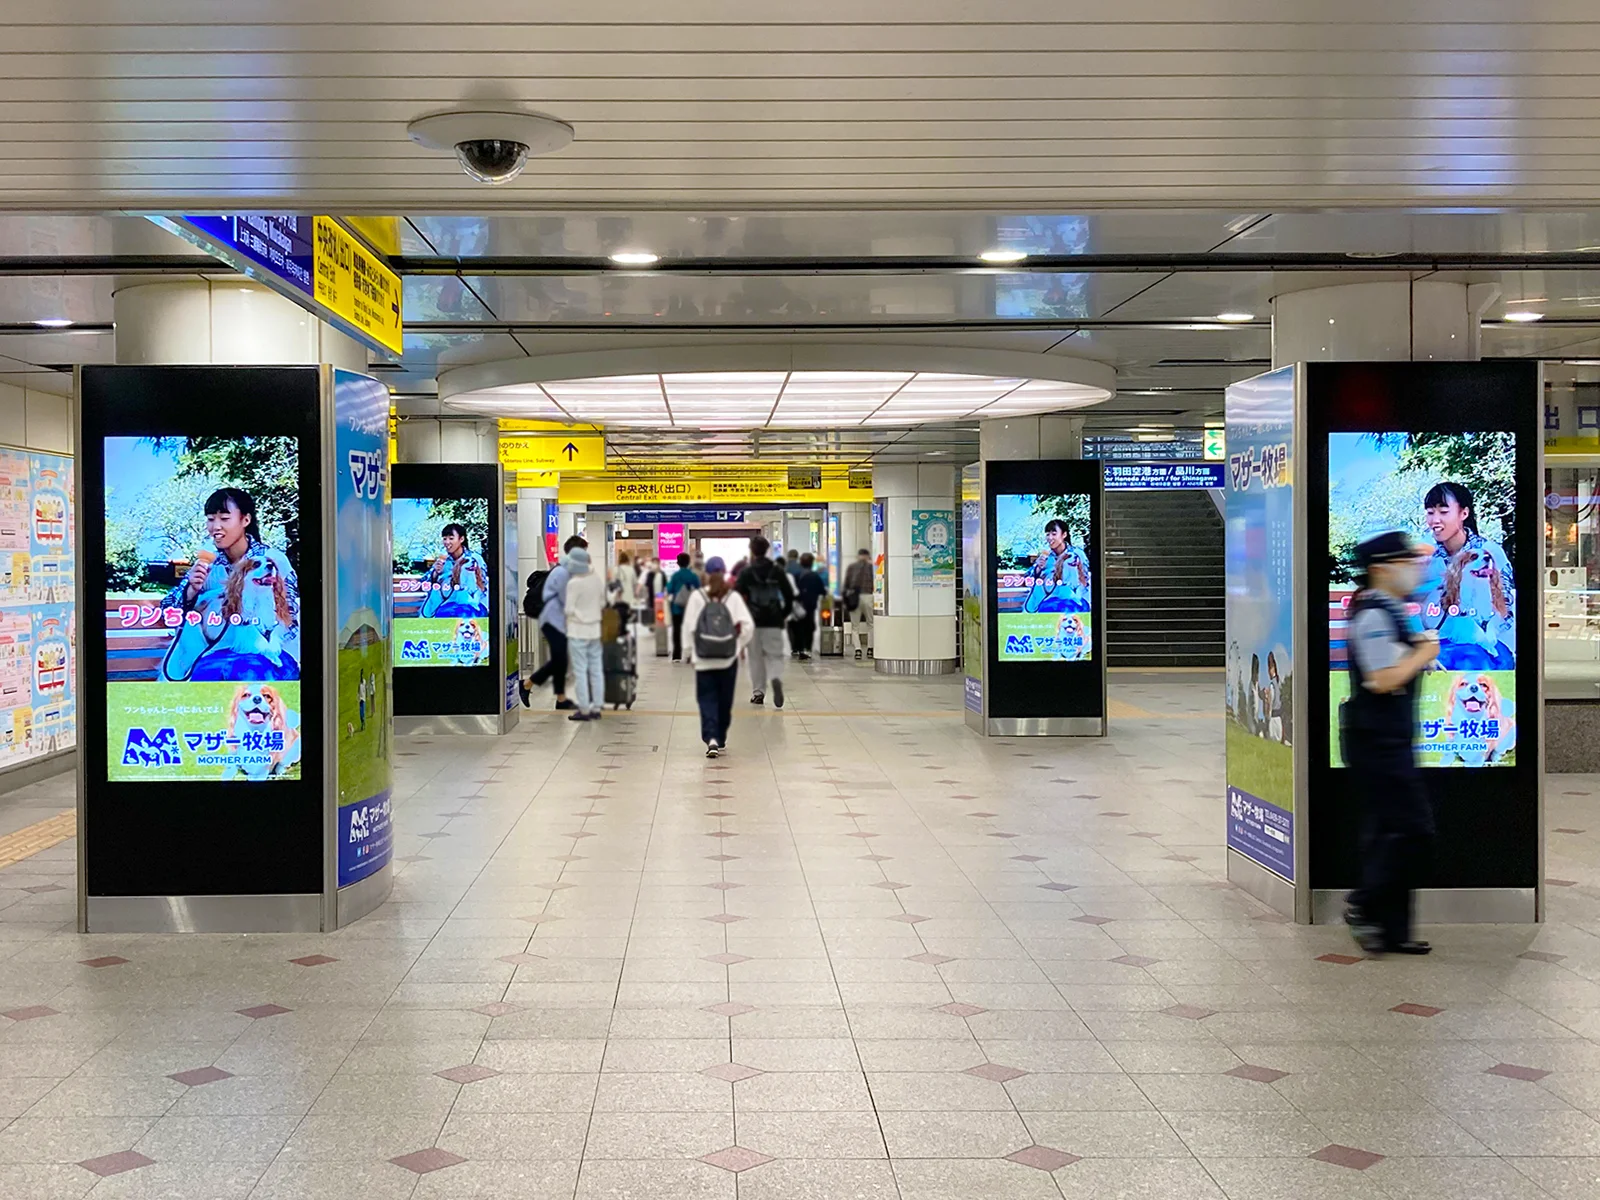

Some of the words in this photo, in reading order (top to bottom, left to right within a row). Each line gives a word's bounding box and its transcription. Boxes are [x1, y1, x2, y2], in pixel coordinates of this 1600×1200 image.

[1544, 438, 1557, 447] xit
[1112, 466, 1167, 476] 羽田空港方面
[1175, 466, 1210, 475] 品川方面
[1229, 444, 1288, 491] マザー牧場
[616, 484, 691, 494] 中央改札(出口)
[431, 641, 481, 652] マザー牧場
[1034, 636, 1084, 647] マザー牧場
[1416, 719, 1500, 739] ザー牧場
[183, 730, 285, 752] マザー牧場
[1460, 743, 1487, 751] FARM
[197, 756, 241, 764] MOTHER
[243, 756, 272, 764] FARM
